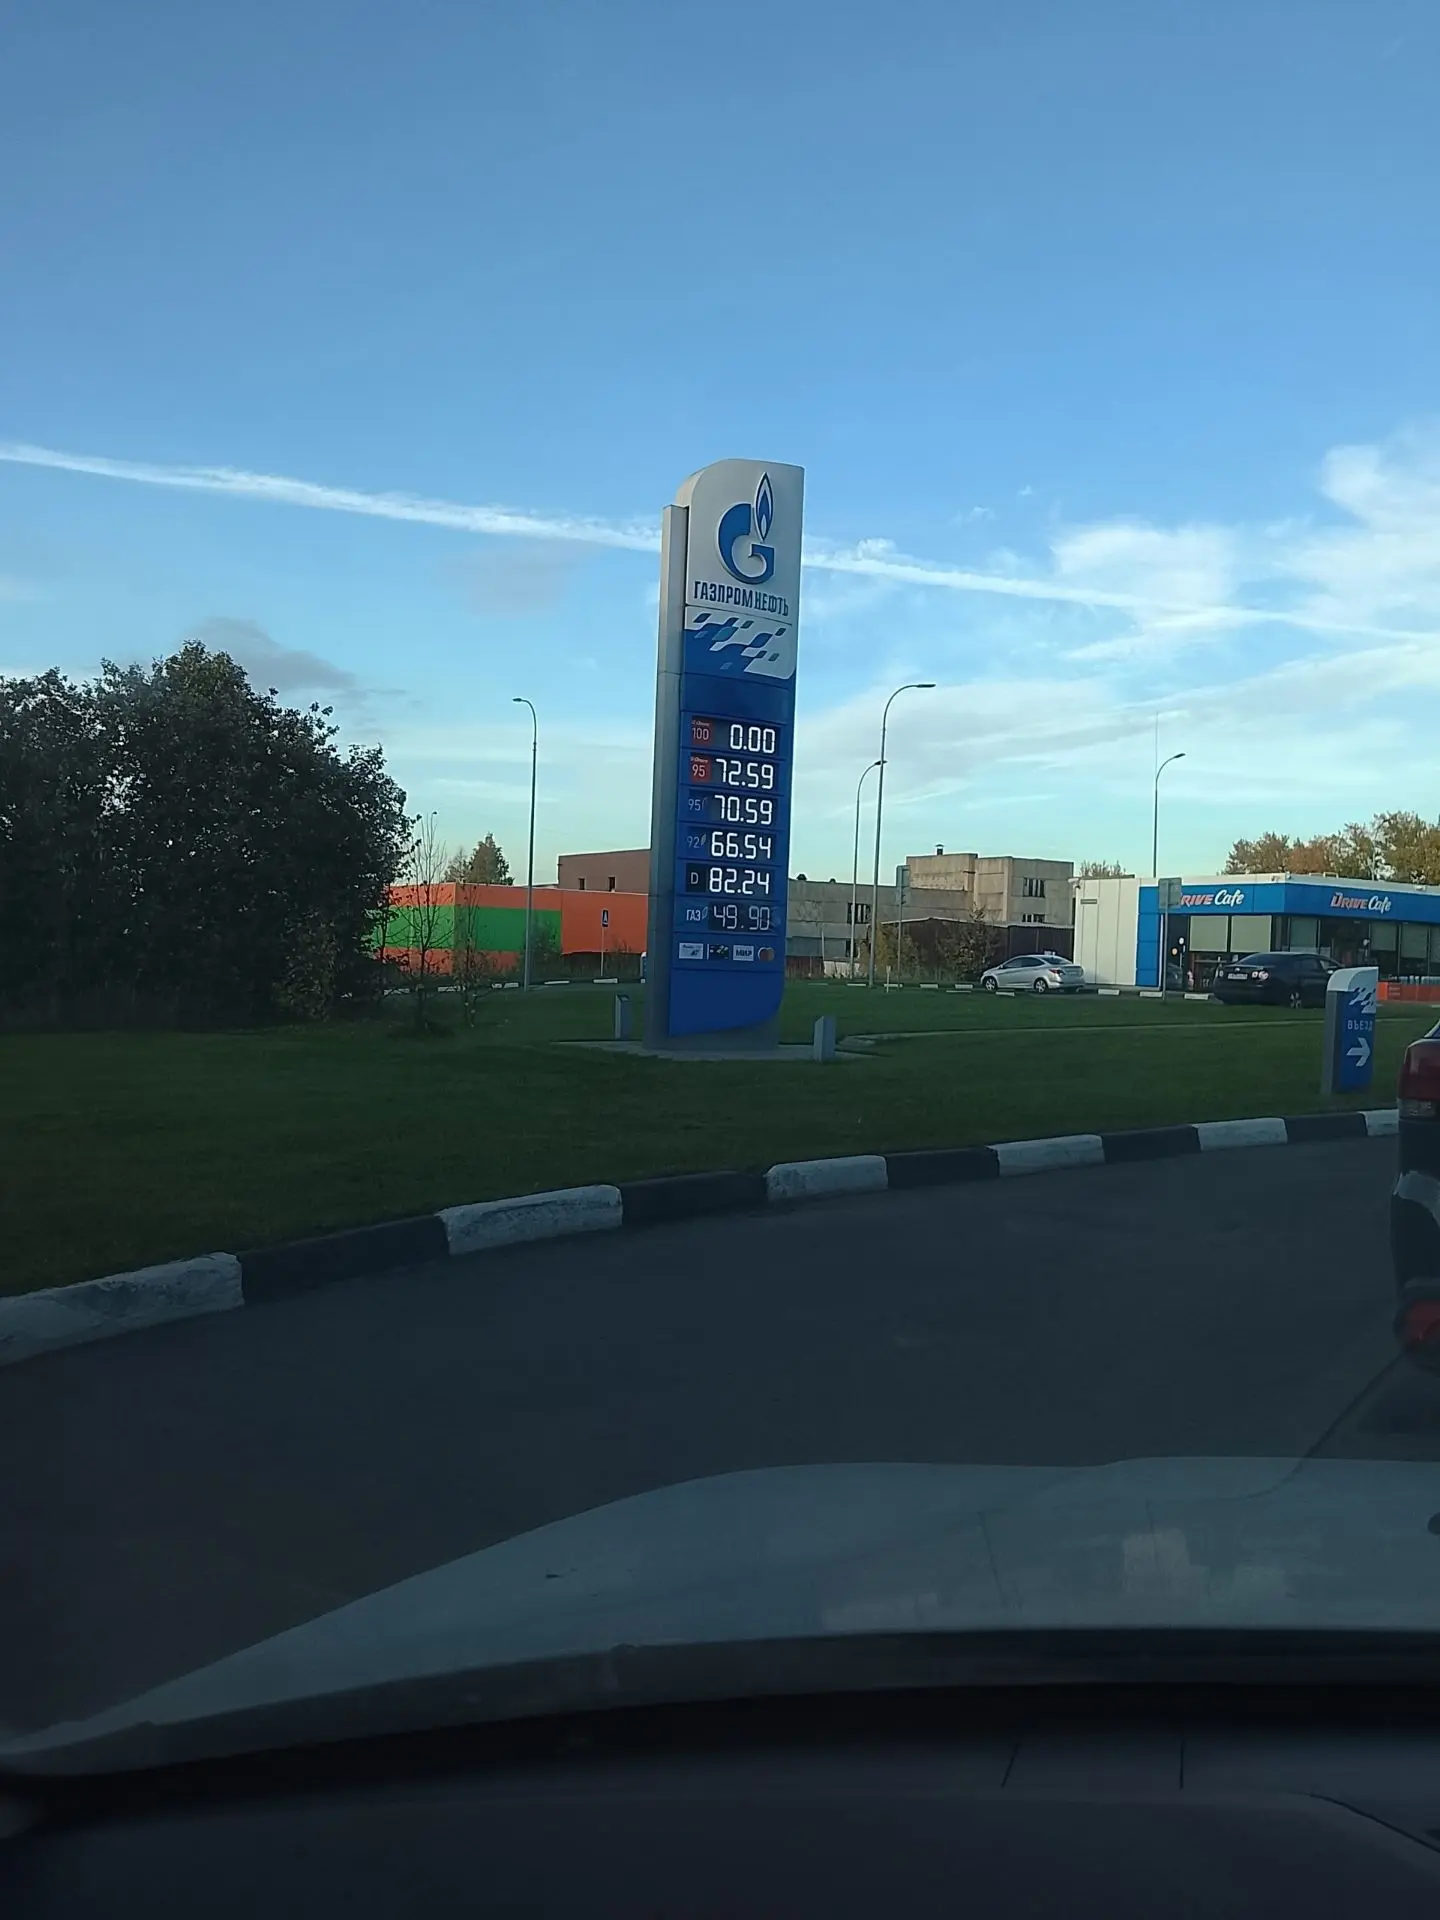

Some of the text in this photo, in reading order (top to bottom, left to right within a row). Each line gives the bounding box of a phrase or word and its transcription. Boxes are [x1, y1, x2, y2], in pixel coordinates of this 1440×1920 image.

[693, 580, 789, 617] ГАЗПРОМНЕФТЬ
[692, 724, 776, 754] 100 0.00
[691, 758, 774, 790] 95 72.59
[688, 794, 773, 825] 95 70.59
[687, 831, 772, 860] 92 66.54
[690, 867, 770, 895] D 82.24
[1180, 889, 1245, 908] RIVE Cafe
[1368, 895, 1392, 914] Cafe
[686, 904, 770, 931] ГАЗ 49.90
